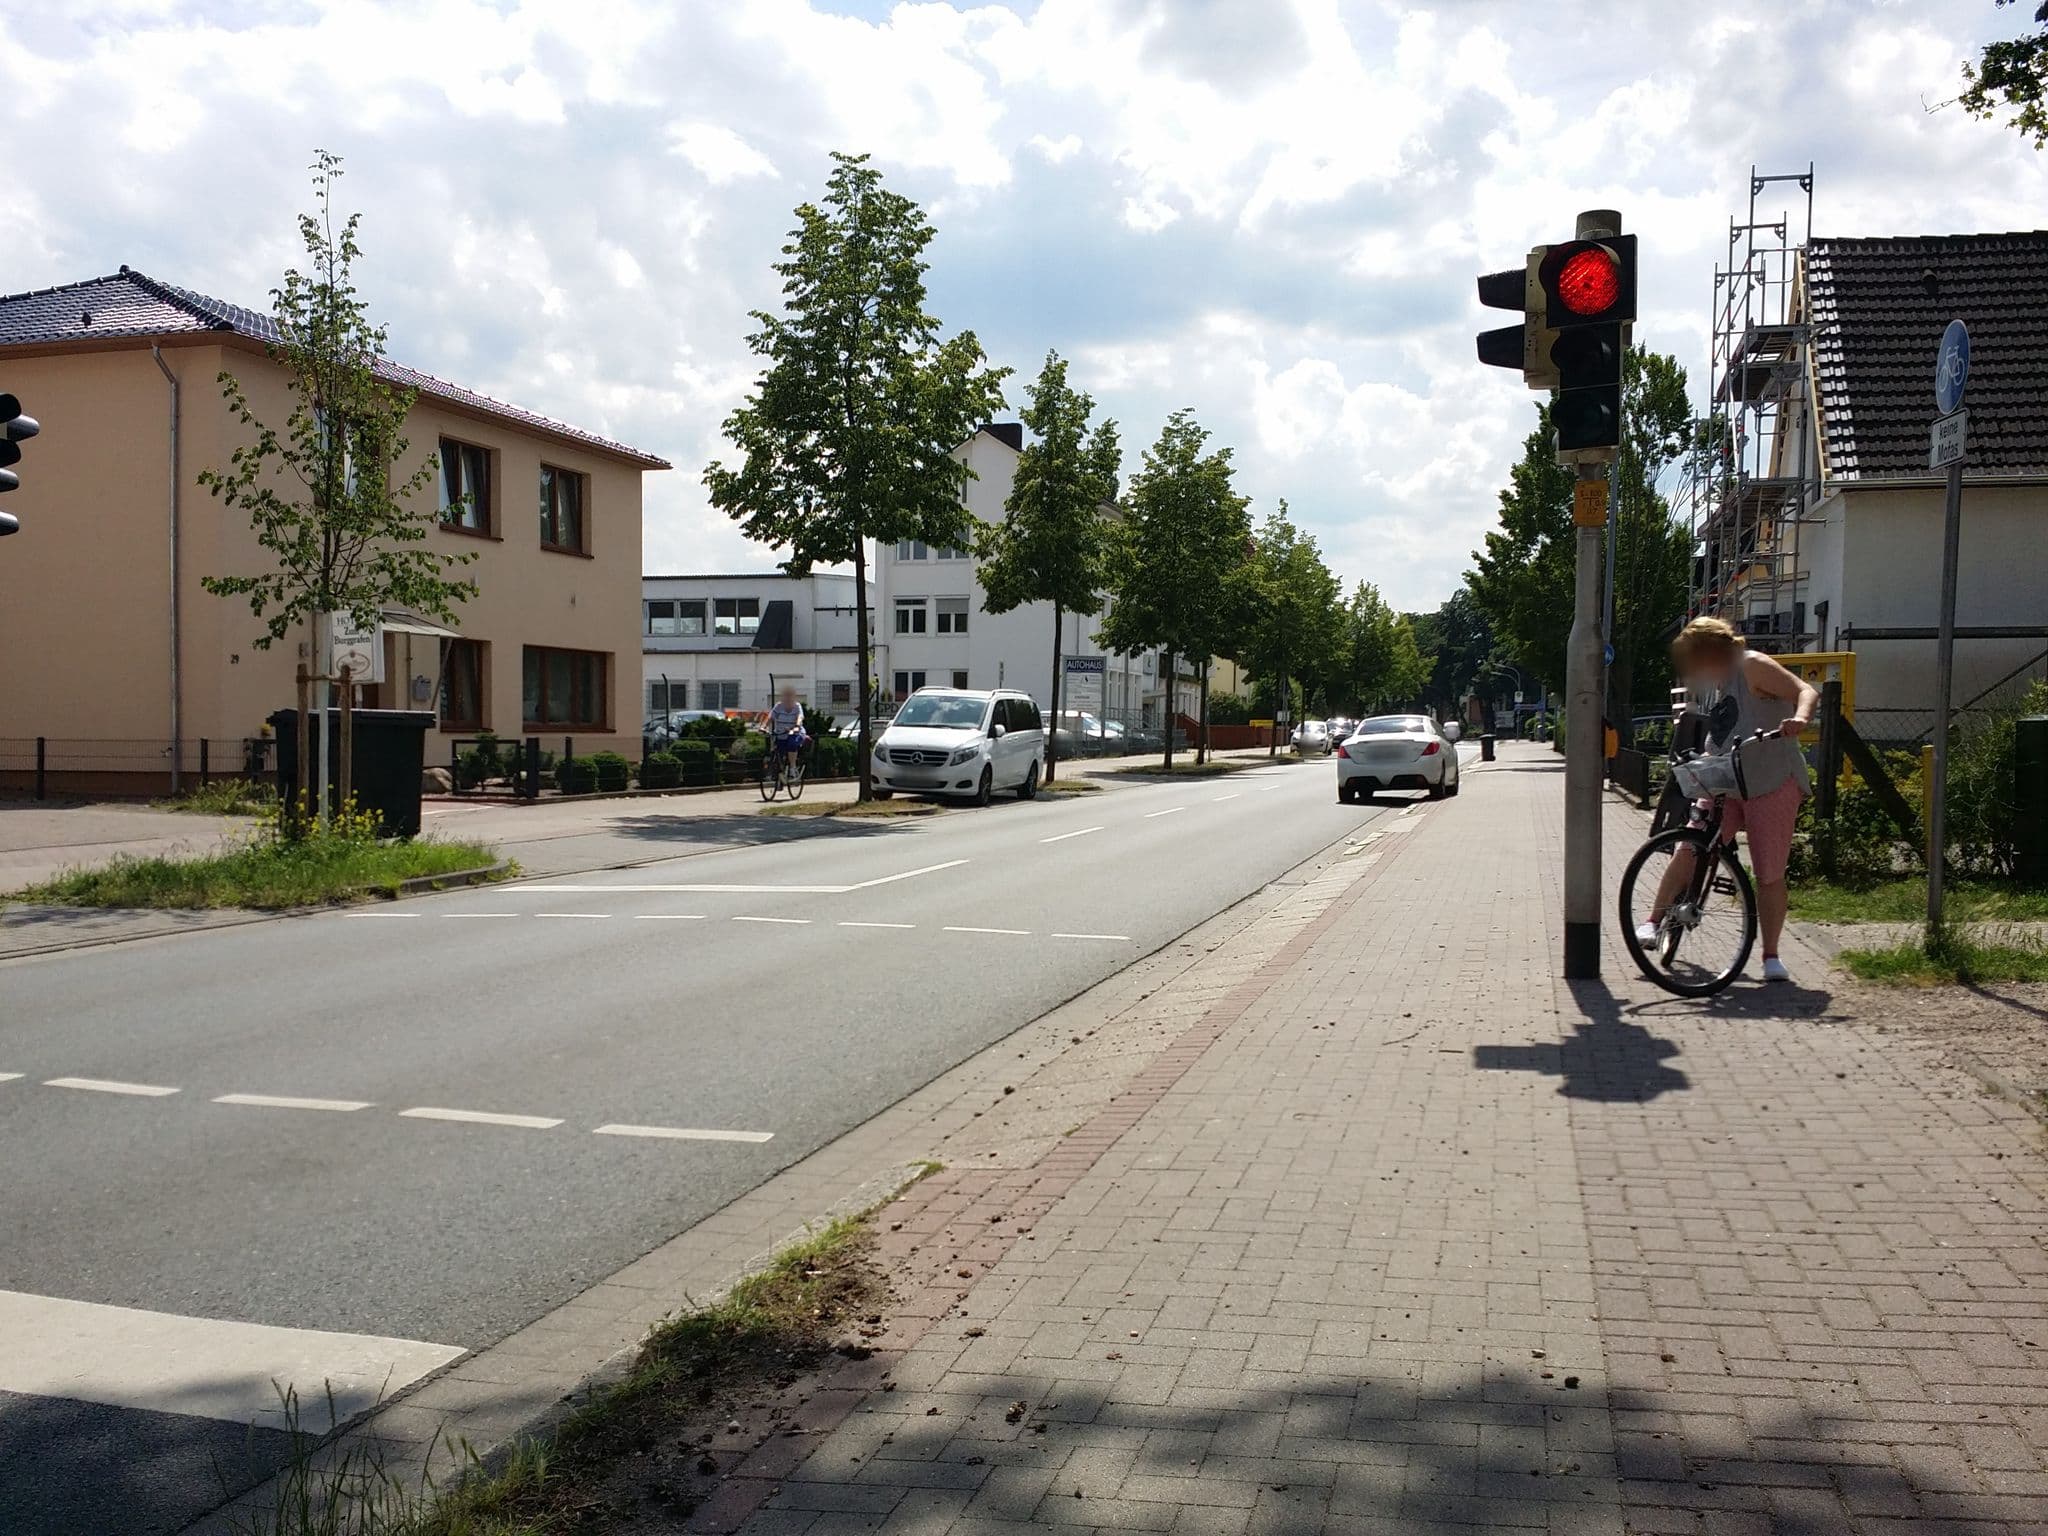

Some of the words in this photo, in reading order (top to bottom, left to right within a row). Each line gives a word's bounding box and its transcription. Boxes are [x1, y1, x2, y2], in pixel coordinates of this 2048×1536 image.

[1939, 421, 1958, 440] keine
[1937, 442, 1958, 463] Mofas
[1066, 659, 1103, 670] AUTOHAUS
